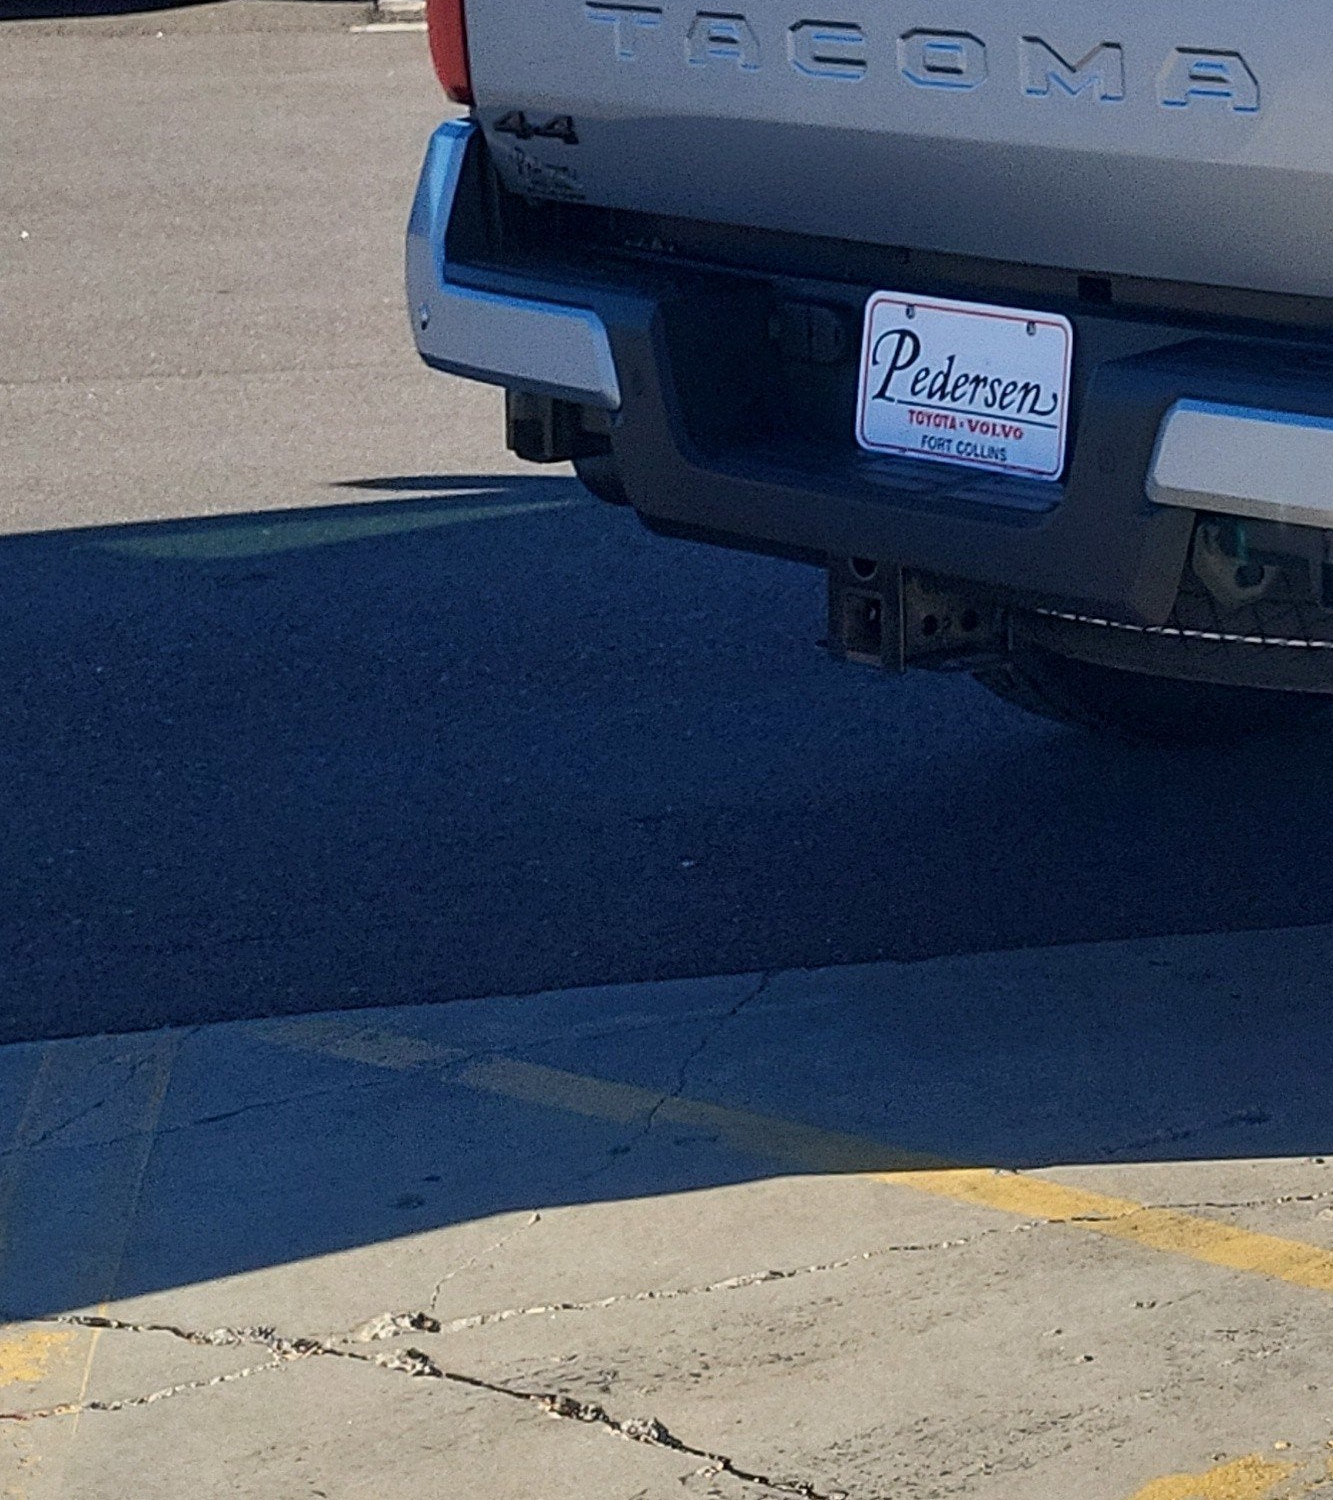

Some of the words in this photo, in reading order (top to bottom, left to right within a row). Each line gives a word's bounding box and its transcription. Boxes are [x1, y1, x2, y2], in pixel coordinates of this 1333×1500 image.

[585, 0, 1261, 113] TACOMA
[871, 328, 1059, 417] Pedersen
[908, 408, 958, 430] TOYOTA
[966, 417, 1024, 441] VOLVO
[920, 434, 953, 453] FORT
[958, 440, 1008, 463] COLLINS
